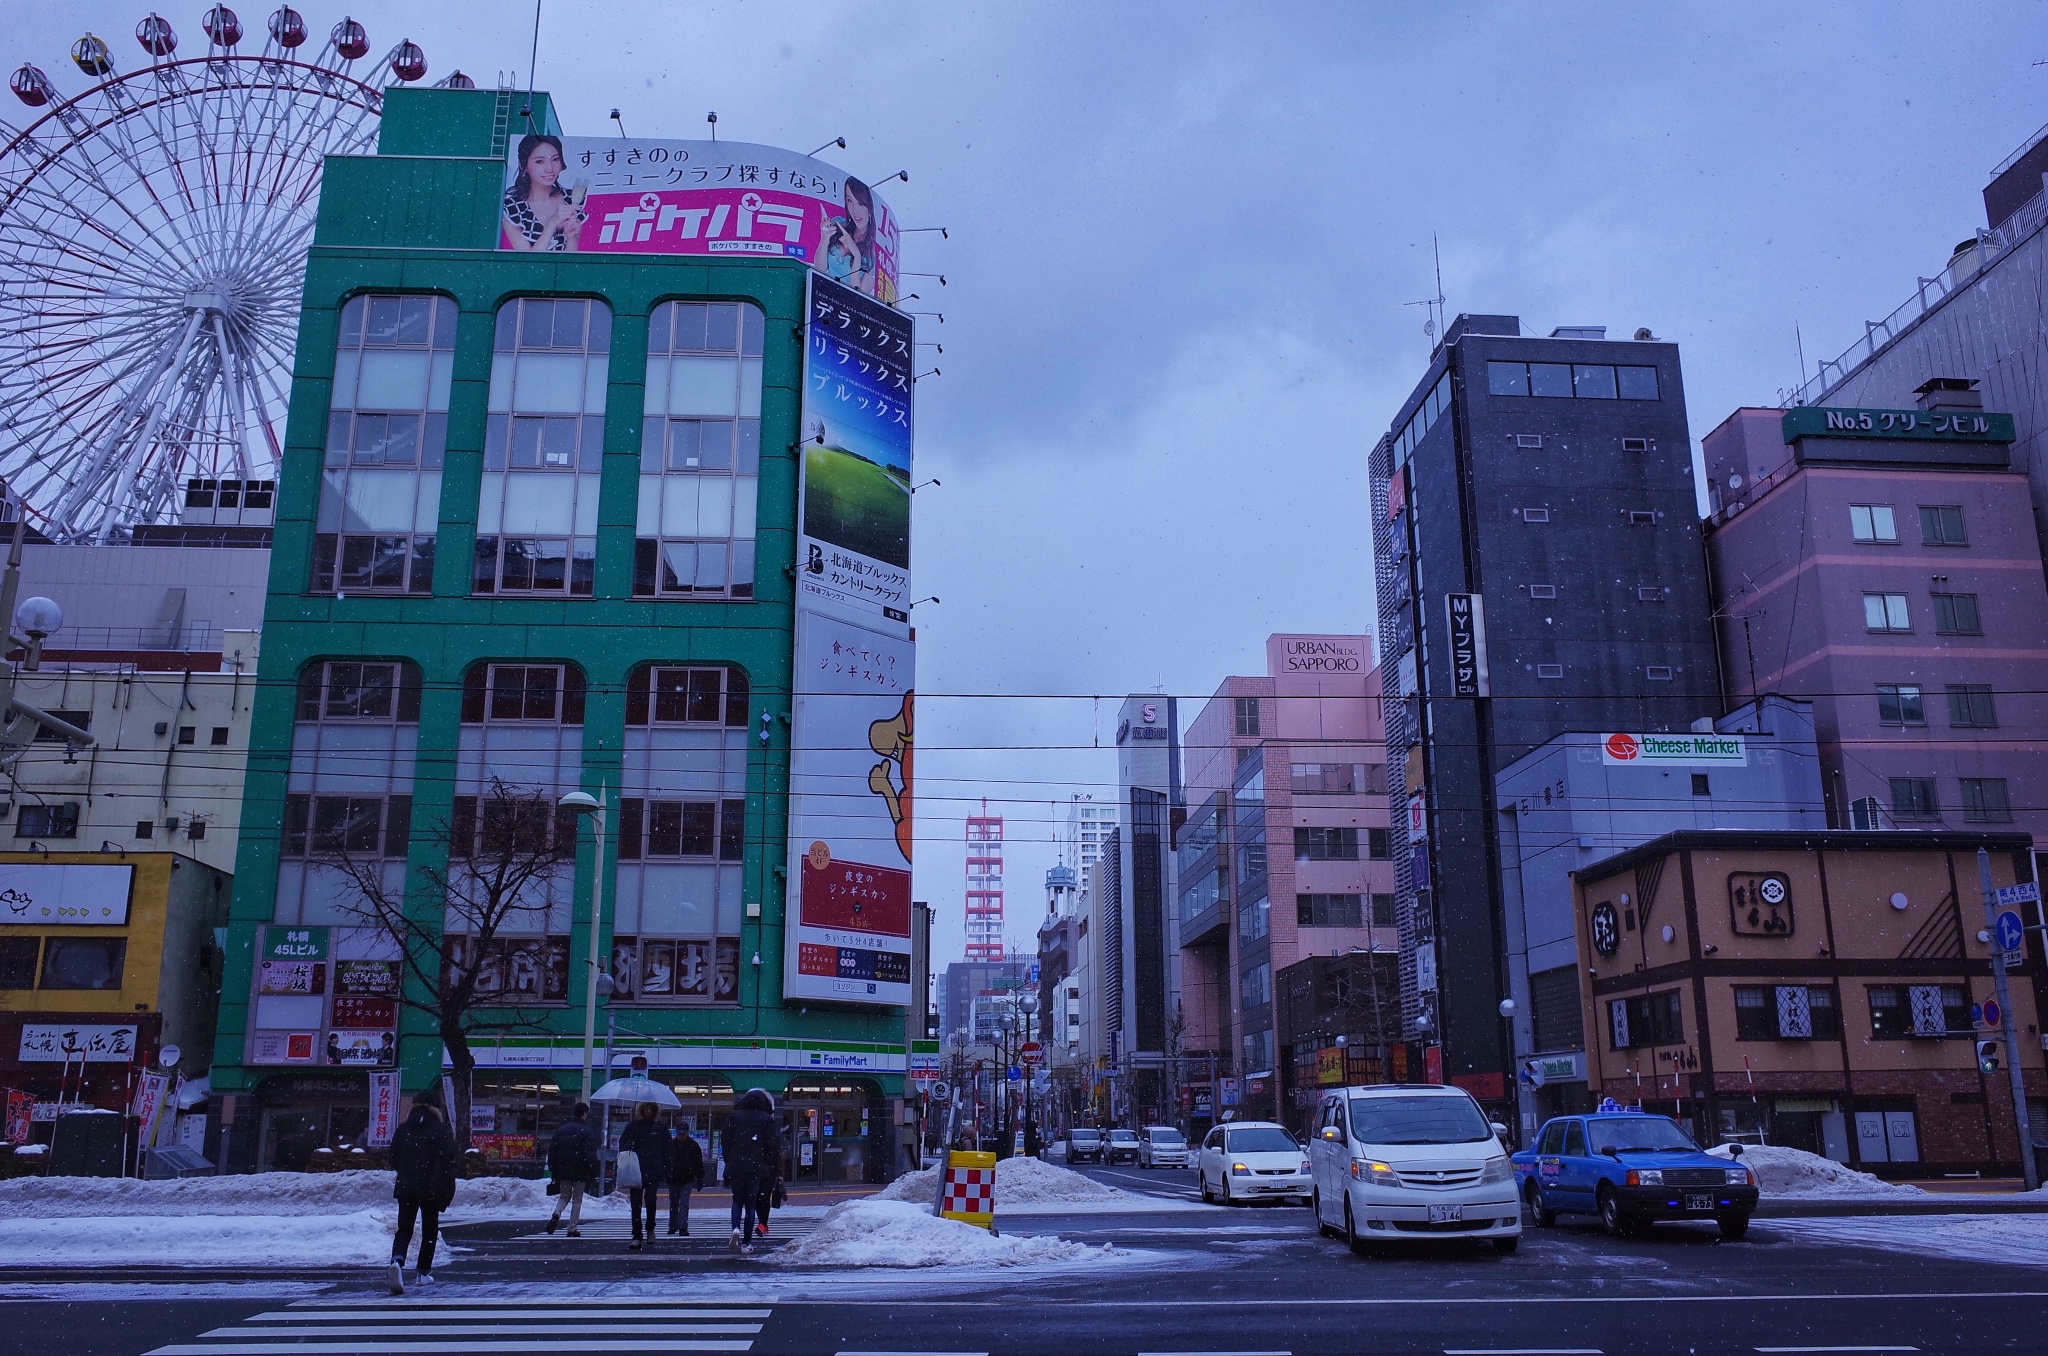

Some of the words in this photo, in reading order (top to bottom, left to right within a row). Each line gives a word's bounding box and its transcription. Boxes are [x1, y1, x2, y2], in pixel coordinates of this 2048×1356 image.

[577, 147, 689, 168] すすきのの
[594, 163, 840, 198] ニュークラブ探すなら!
[599, 193, 804, 244] ポケパラ
[744, 243, 773, 251] すすきの
[816, 300, 909, 358] デラックス
[815, 336, 908, 393] リラックス
[813, 372, 907, 428] ブルックス
[1826, 411, 1873, 430] No.5
[1880, 413, 1989, 433] グリーンビル
[831, 552, 907, 588] 北海道ブルックス
[804, 584, 846, 602] 北海道ブルックス
[830, 571, 902, 602] カントリークラブ
[831, 639, 895, 669] 食べてく?
[1287, 641, 1335, 655] URBAN
[1336, 647, 1358, 656] BLDG.
[1288, 657, 1359, 671] SAPPORO
[1643, 737, 1691, 753] Cheese
[1694, 738, 1740, 755] Market
[810, 847, 829, 857] 当ビル
[815, 857, 823, 865] 4F
[845, 871, 874, 883] 夜空の
[829, 884, 888, 900] ジンギスカン
[287, 930, 310, 942] 札幌
[274, 944, 319, 956] 45Lビル
[802, 955, 833, 963] ジンギスカン
[614, 943, 738, 994] 酒場
[840, 968, 871, 976] ジンギスカン
[878, 962, 907, 972] ジンギスカン
[293, 964, 310, 992] 桜坂
[336, 1010, 391, 1018] ジンギスカン
[24, 1040, 56, 1053] 札幌
[61, 1029, 132, 1054] 直伝屋
[824, 1054, 867, 1067] FamilyMart
[376, 1088, 391, 1139] 女性無料
